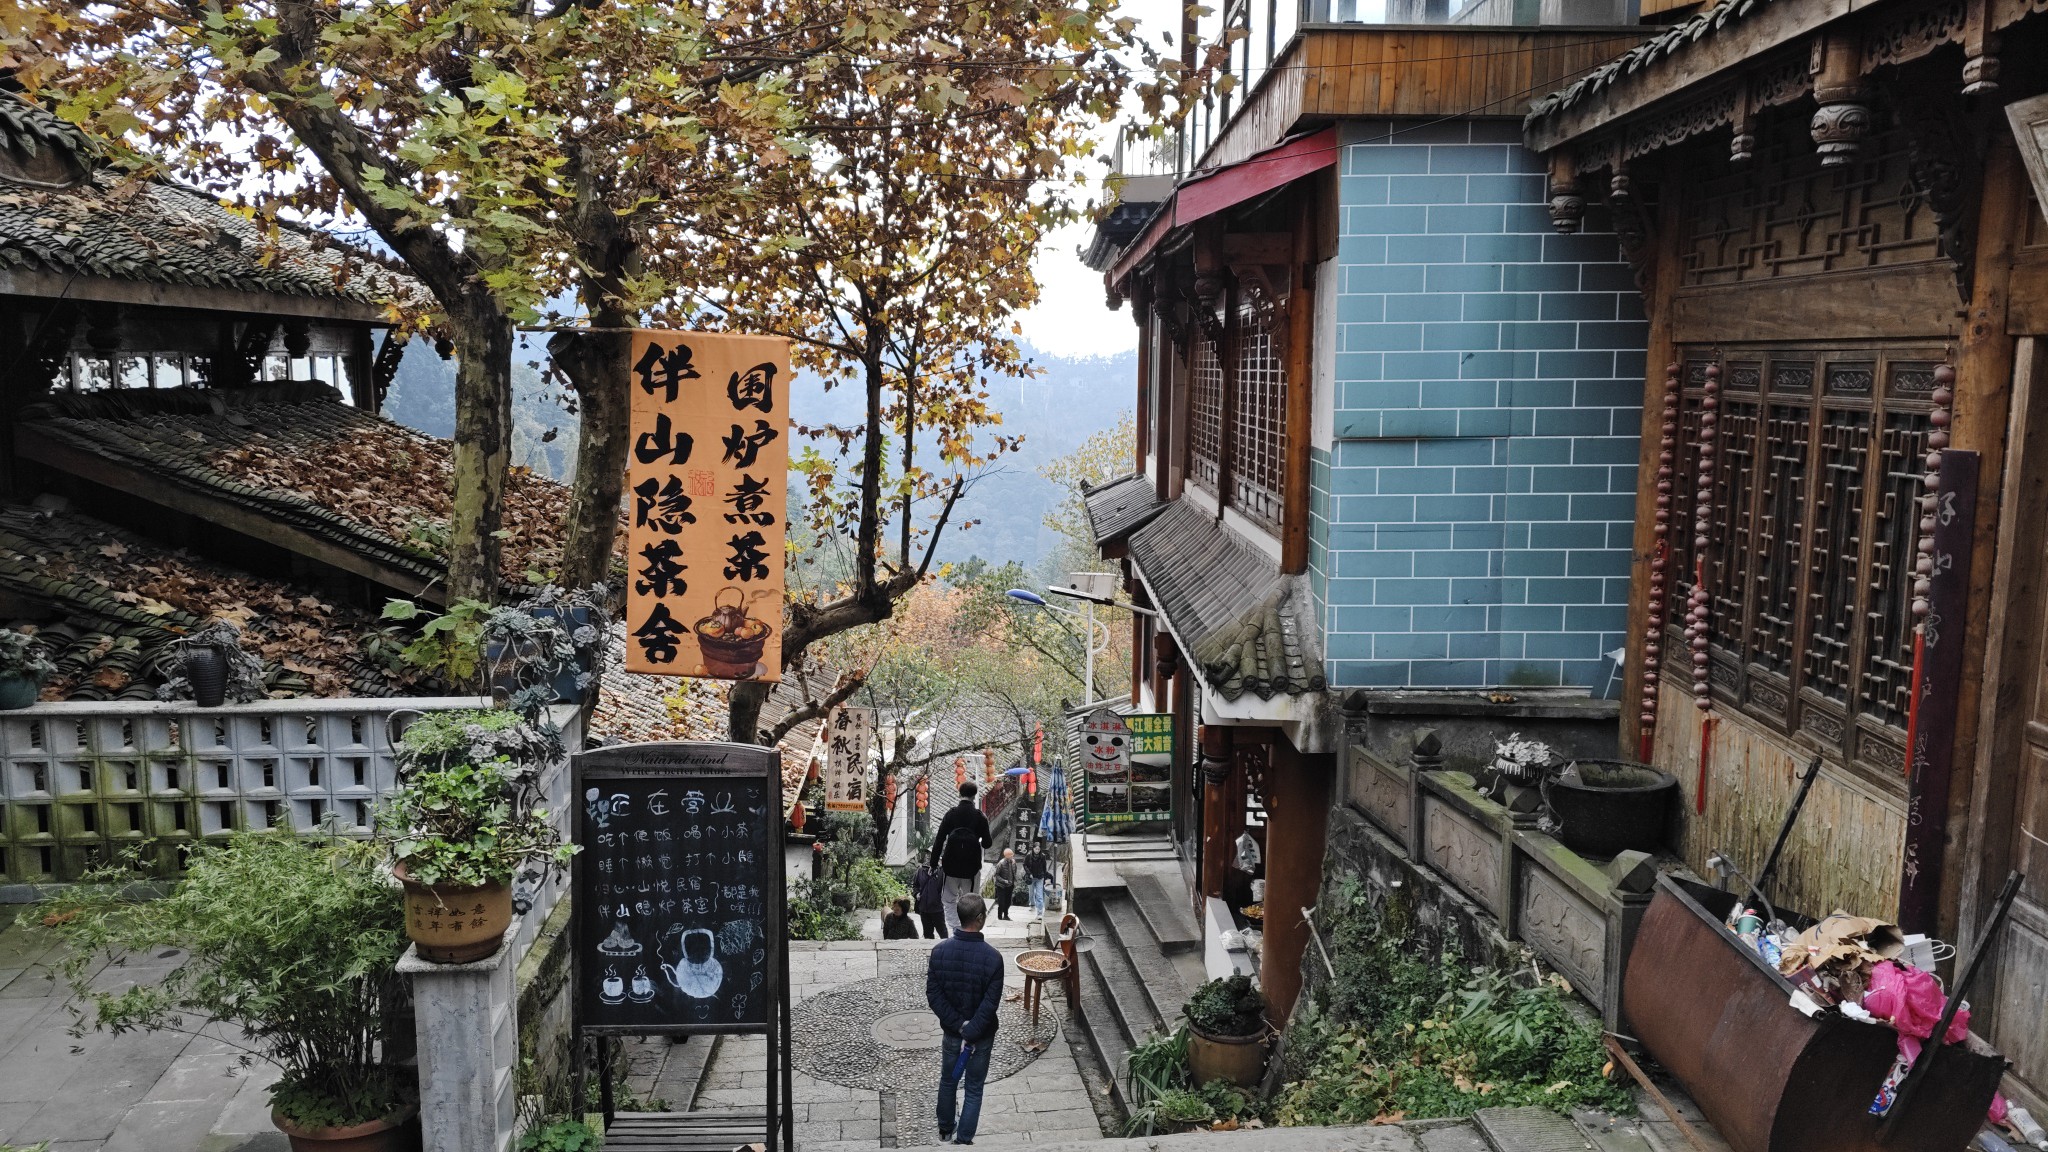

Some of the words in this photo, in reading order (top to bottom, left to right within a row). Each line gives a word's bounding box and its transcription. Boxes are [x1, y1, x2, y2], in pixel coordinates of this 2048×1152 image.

[632, 341, 701, 664] 伴山隐茶舍
[722, 362, 778, 582] 围炉煮茶
[846, 753, 864, 801] 民宿
[1094, 746, 1115, 755] 冰粉
